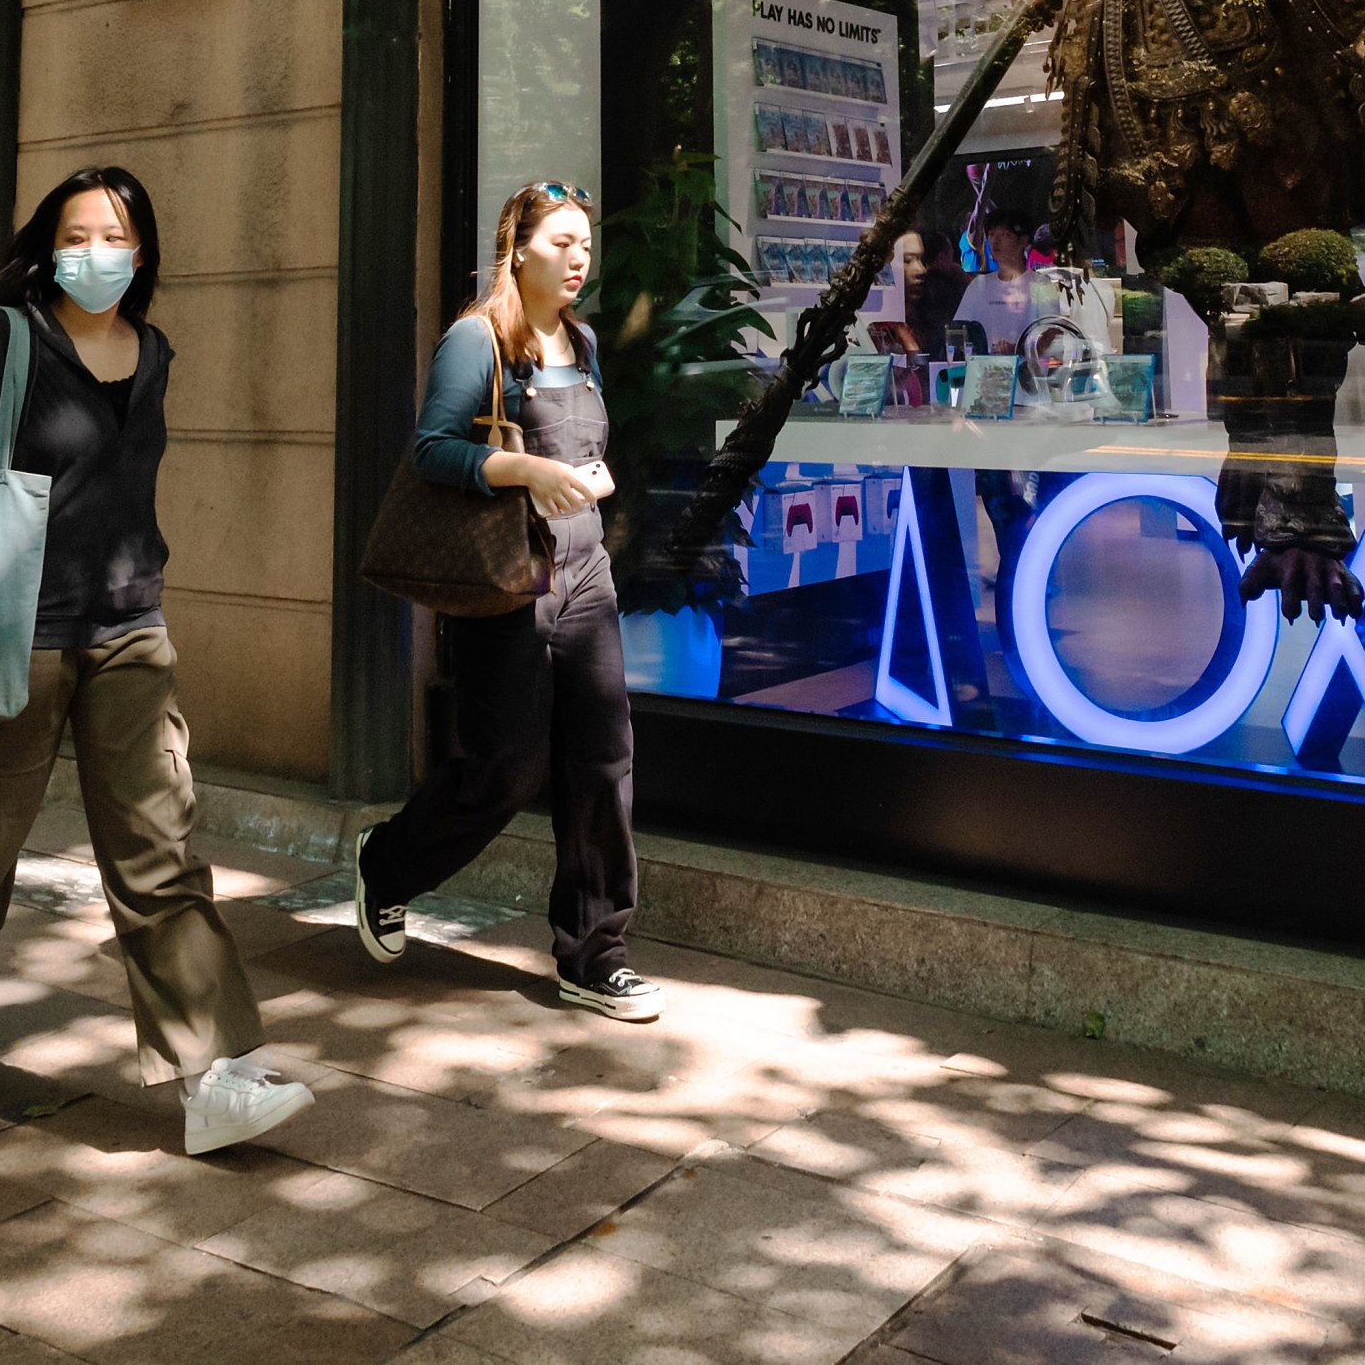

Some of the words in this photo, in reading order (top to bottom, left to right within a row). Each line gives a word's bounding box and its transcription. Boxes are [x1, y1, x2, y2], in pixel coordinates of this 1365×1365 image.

[752, 0, 784, 23] PLAY
[787, 8, 813, 30] HAS
[816, 15, 835, 34] NO
